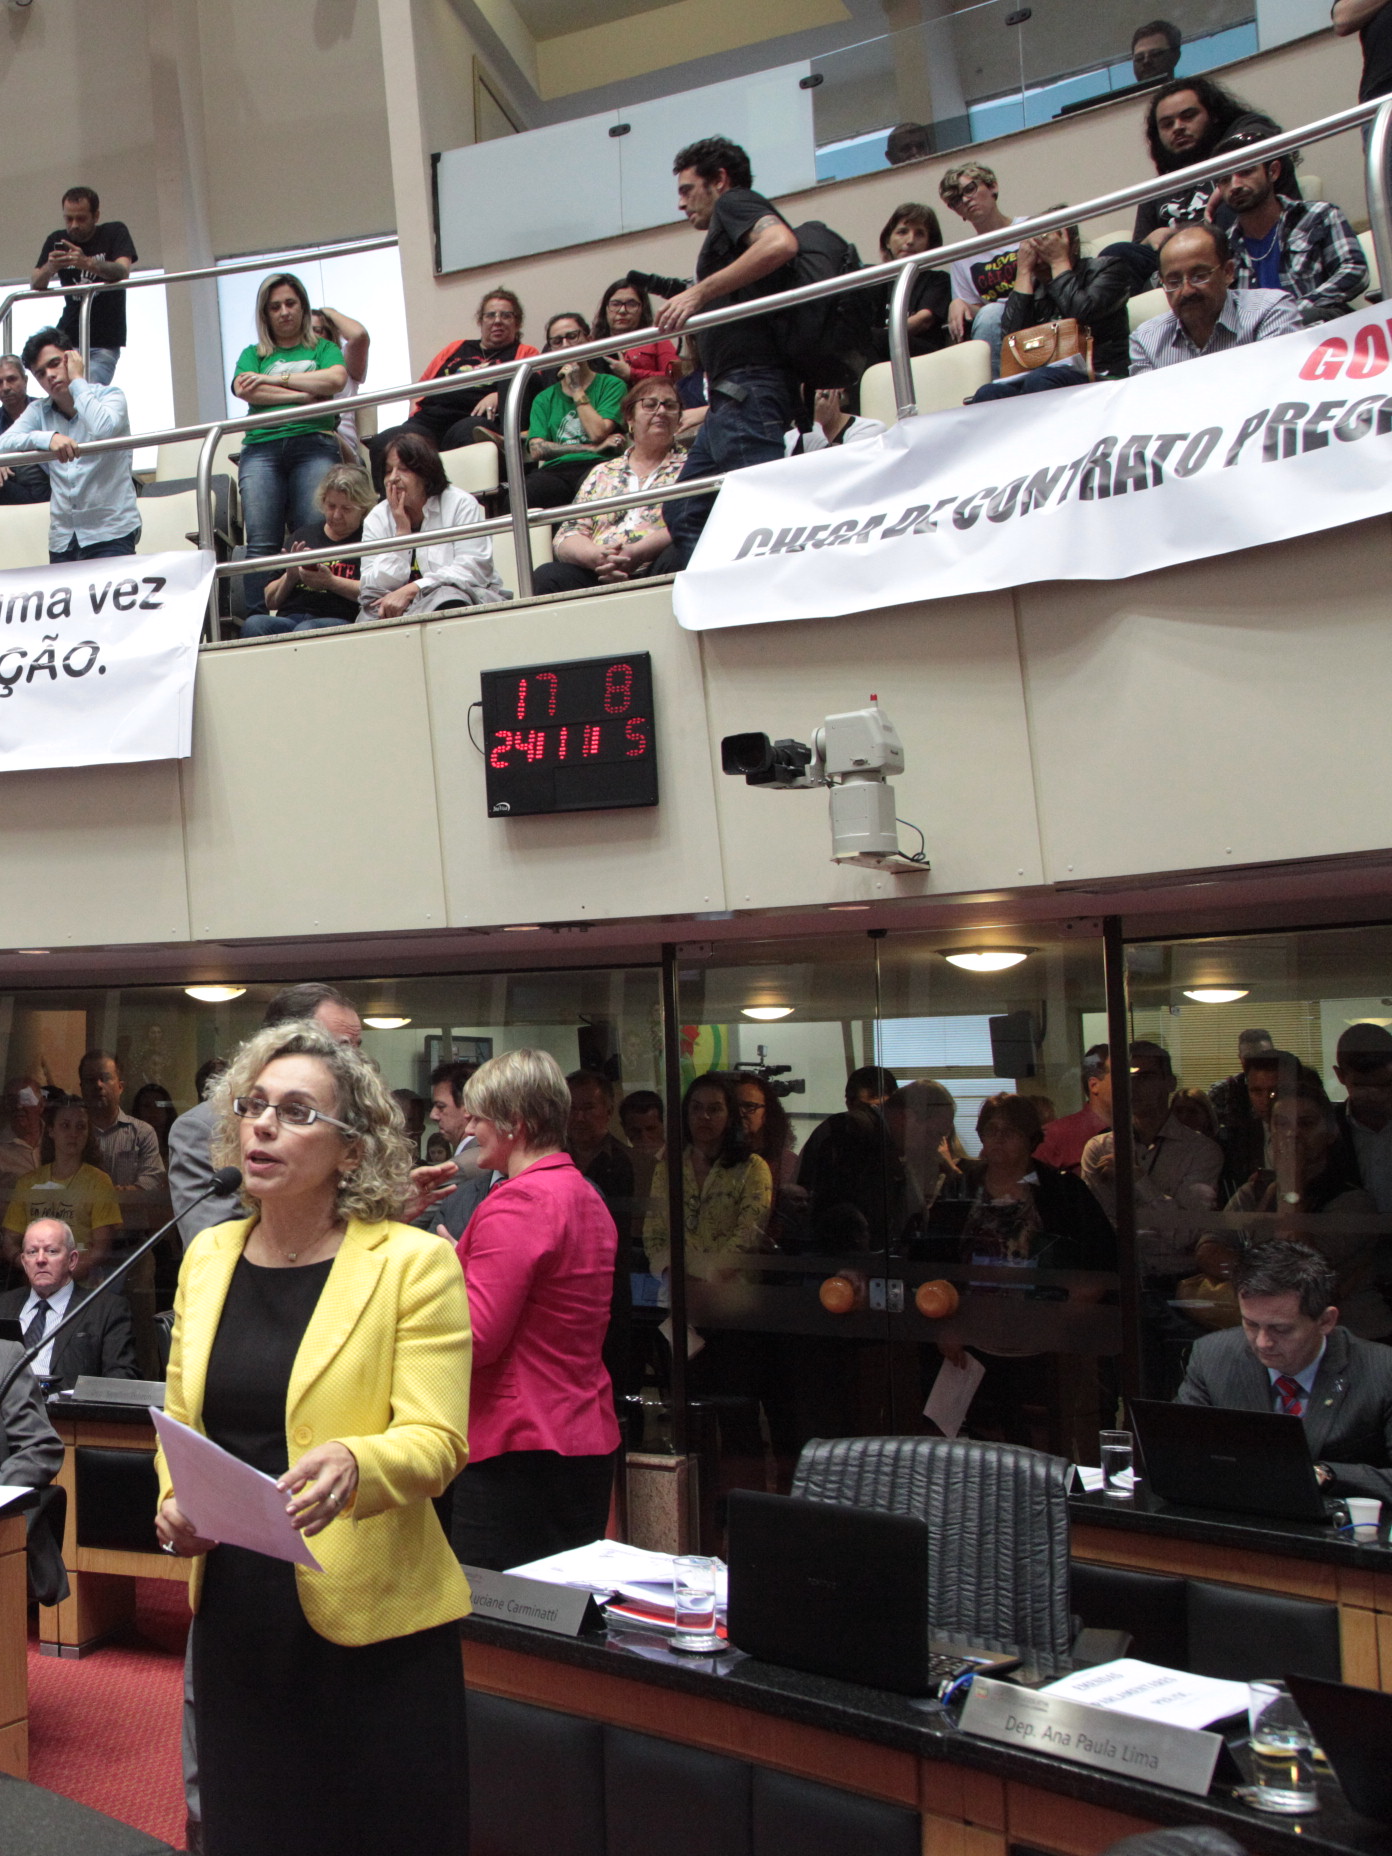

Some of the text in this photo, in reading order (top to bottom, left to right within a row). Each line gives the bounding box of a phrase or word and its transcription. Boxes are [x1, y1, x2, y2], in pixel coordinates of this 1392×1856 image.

[1299, 318, 1392, 381] GO
[952, 426, 1224, 531] CONTRATO
[89, 577, 168, 615] vez
[516, 673, 558, 721] 17
[506, 1599, 559, 1622] Carminatti
[1005, 1715, 1159, 1769] Dep. Ana Paula Lima
